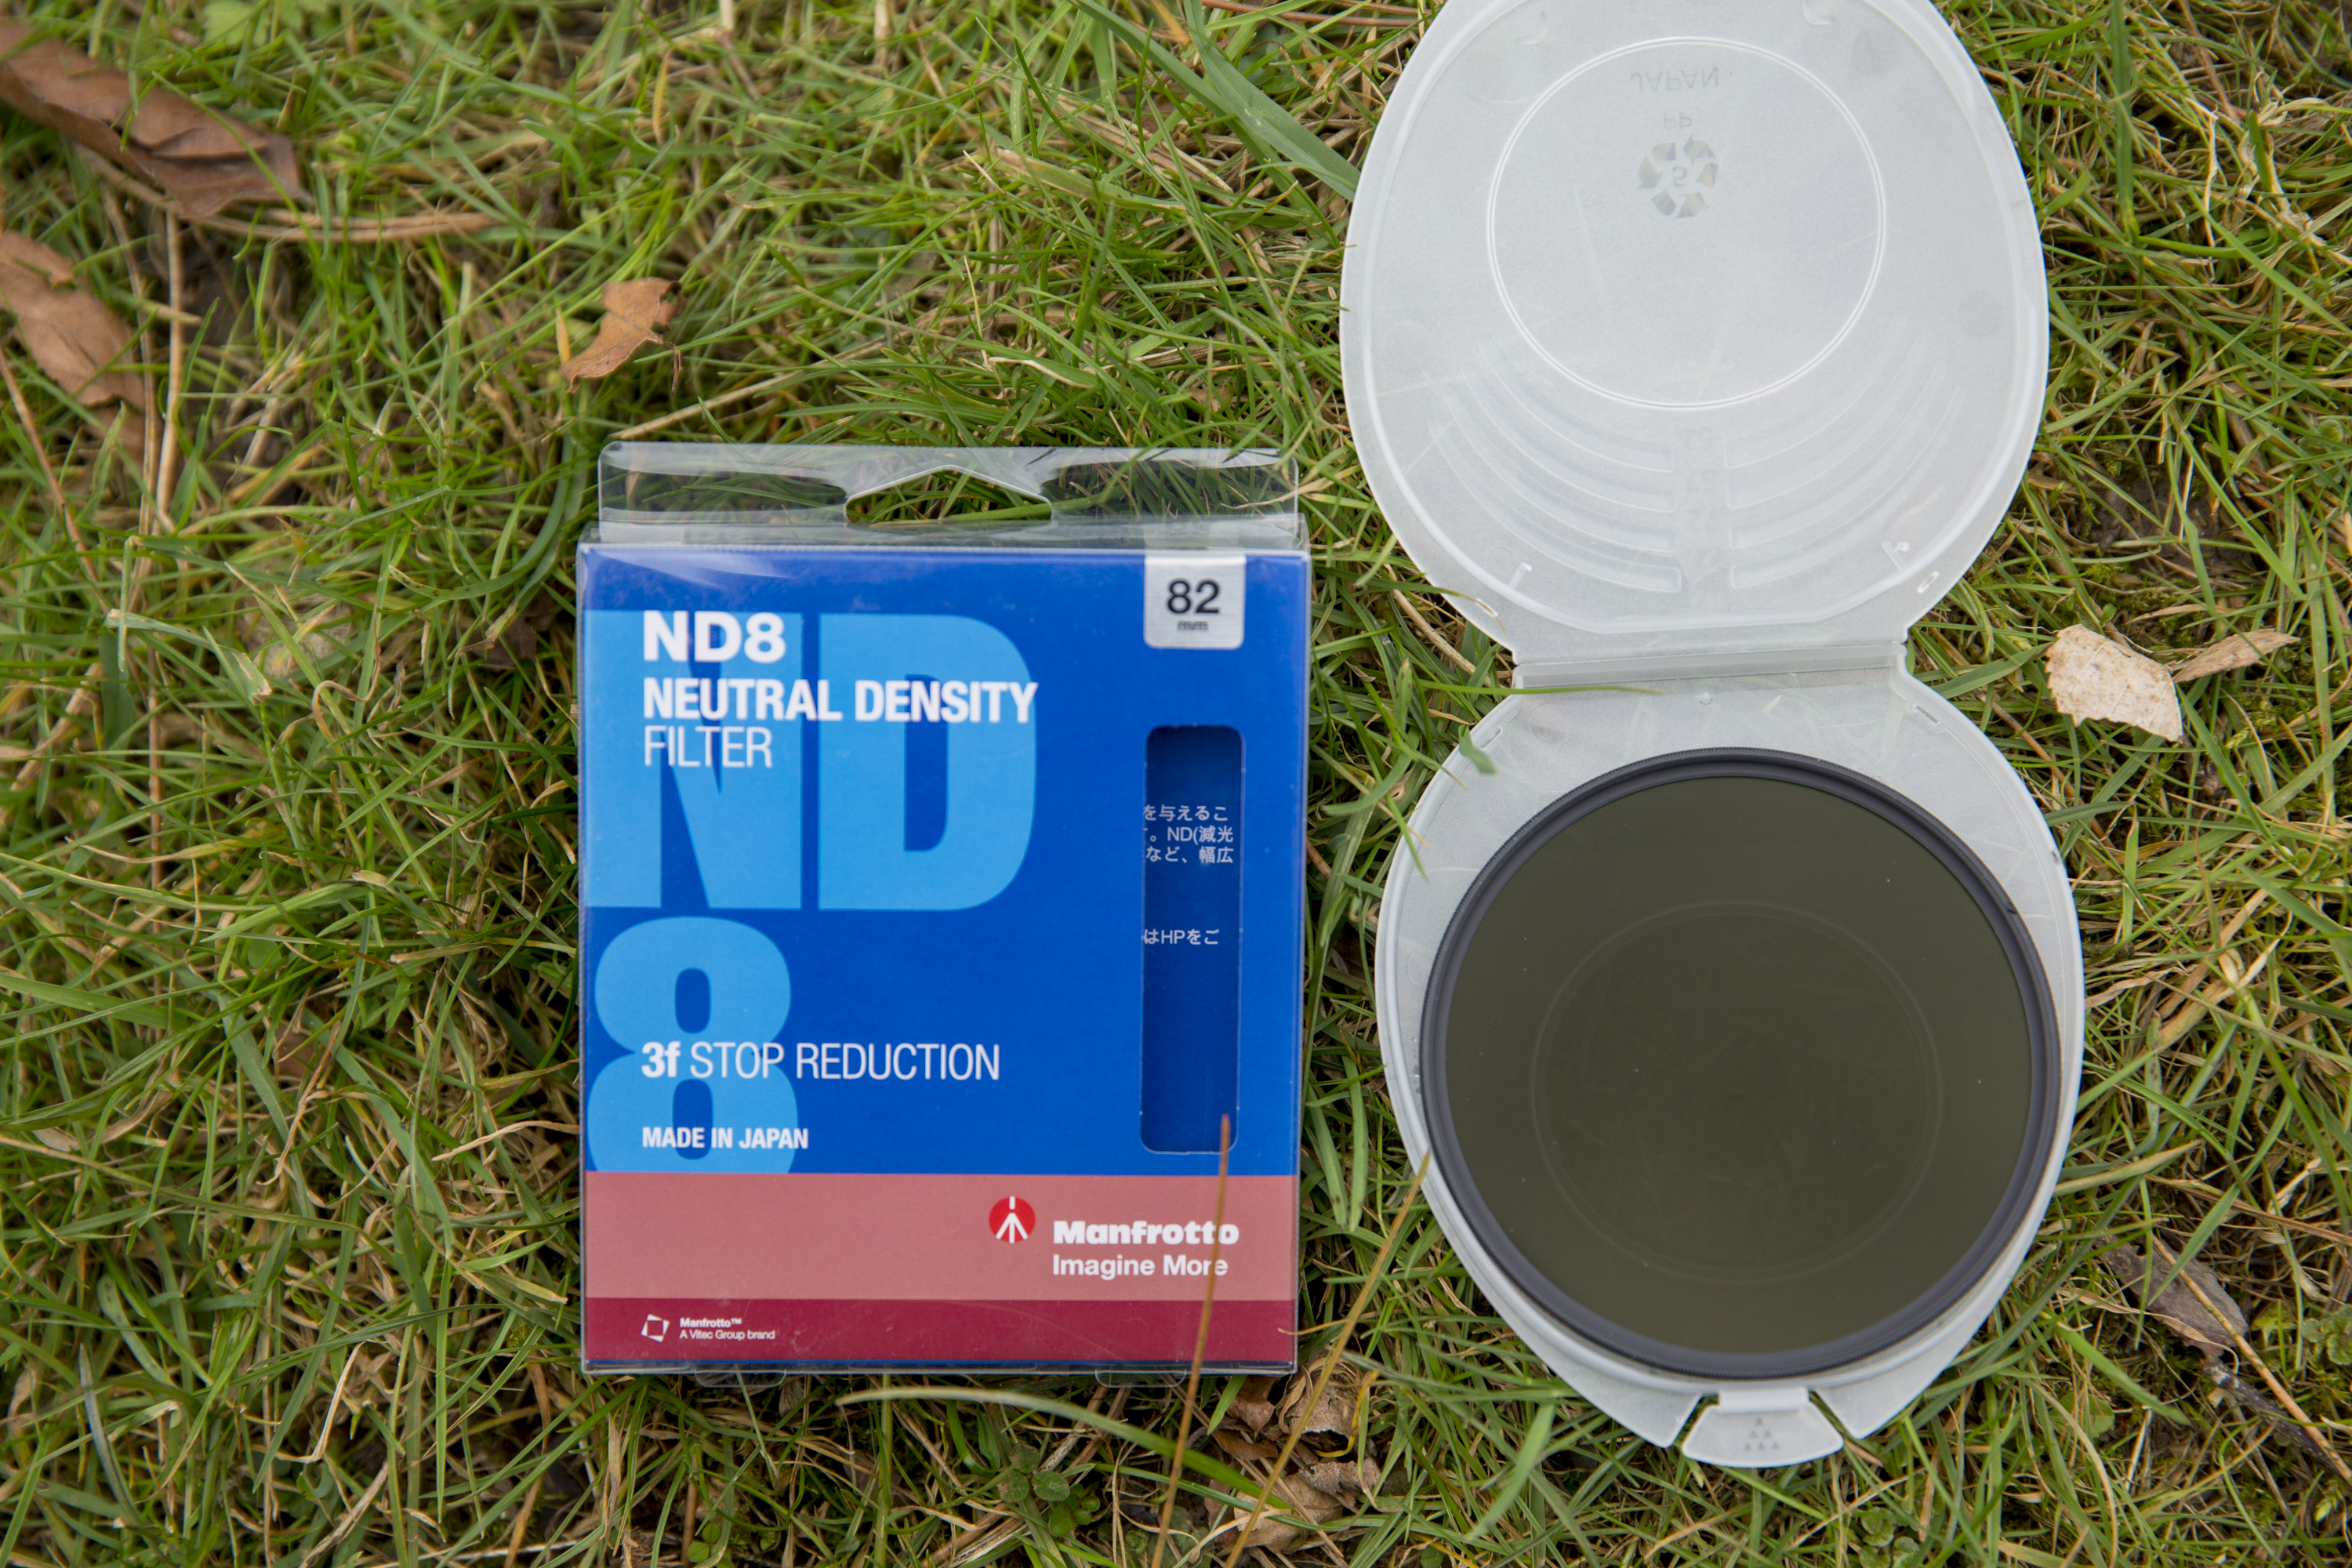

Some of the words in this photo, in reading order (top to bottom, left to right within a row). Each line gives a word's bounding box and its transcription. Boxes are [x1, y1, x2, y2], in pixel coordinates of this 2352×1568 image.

[1167, 578, 1221, 614] 82
[643, 609, 786, 662] ND8
[1177, 621, 1209, 631] mm
[643, 677, 843, 720] NEUTRAL
[855, 680, 1039, 724] DENSITY
[583, 609, 1037, 910] ND
[644, 725, 774, 768] FILTER
[641, 1041, 681, 1078] 3f
[690, 1041, 785, 1079] STOP
[797, 1043, 1000, 1080] REDUCTION
[642, 1127, 705, 1148] MADE
[710, 1127, 733, 1148] IN
[739, 1127, 808, 1149] JAPAN
[1052, 1220, 1240, 1245] Manfrotto
[1053, 1254, 1156, 1281] Imagine
[1163, 1254, 1229, 1276] More
[679, 1330, 688, 1340] A
[689, 1329, 713, 1340] Vitec
[715, 1330, 746, 1341] Group
[746, 1330, 775, 1340] brand
